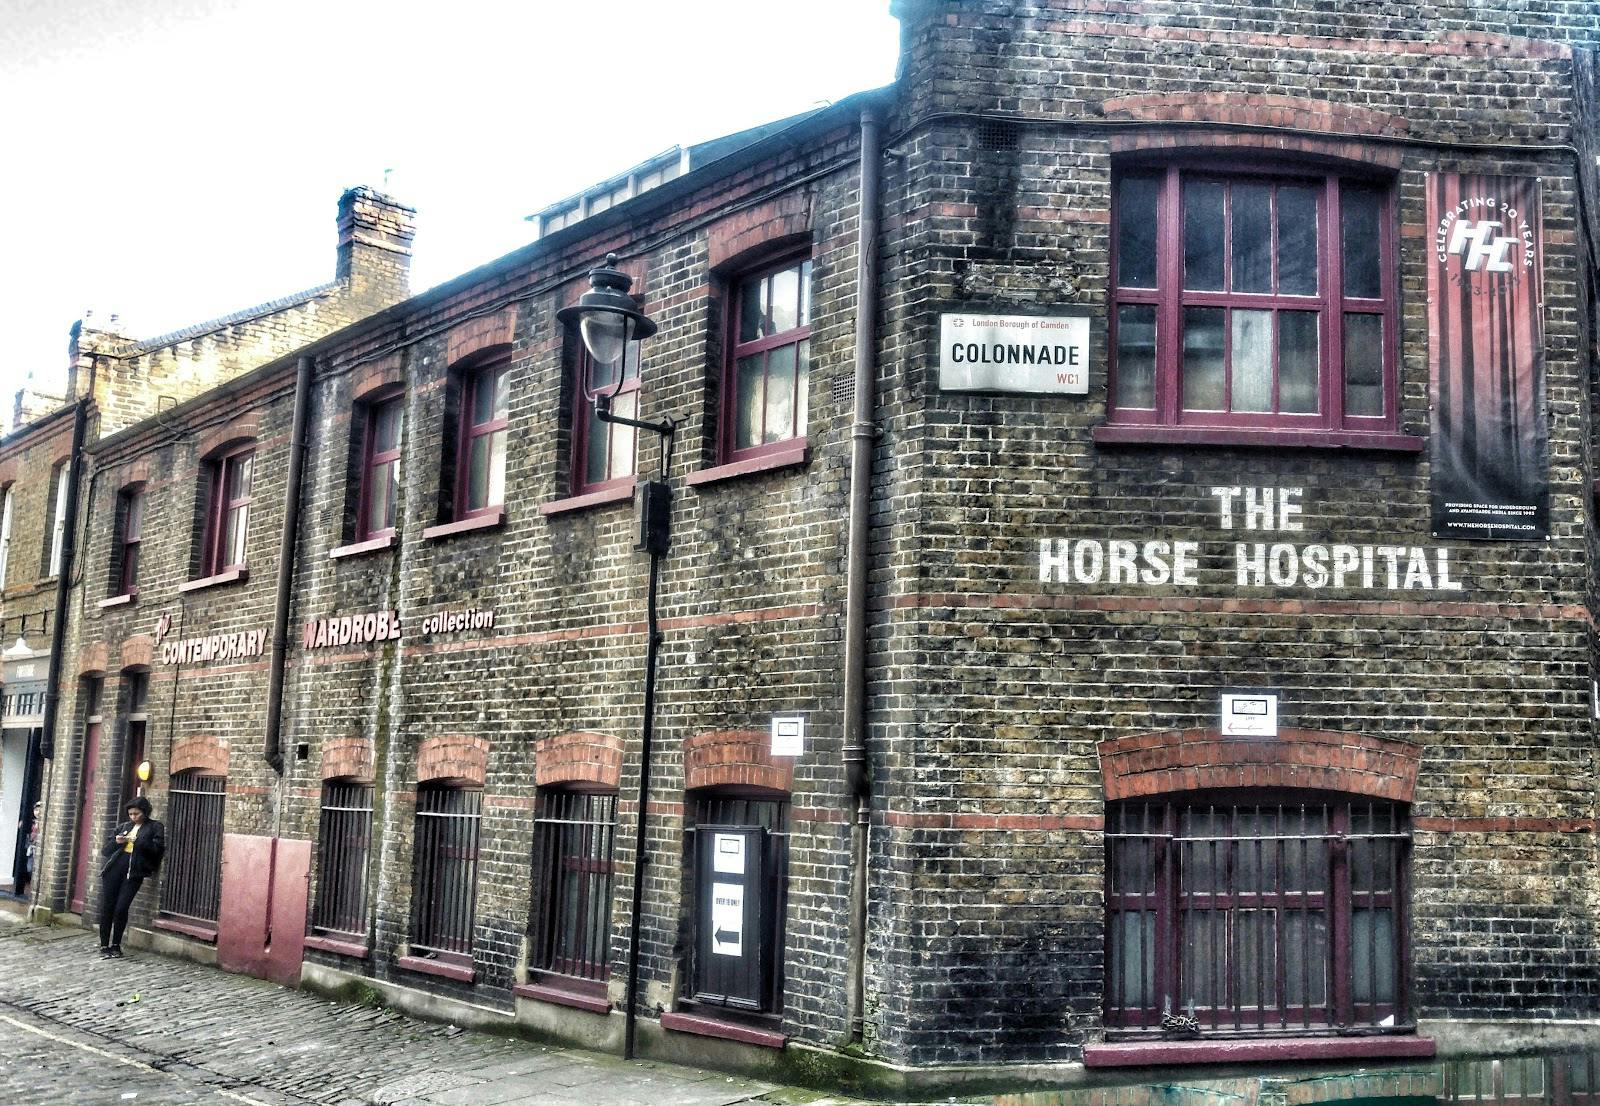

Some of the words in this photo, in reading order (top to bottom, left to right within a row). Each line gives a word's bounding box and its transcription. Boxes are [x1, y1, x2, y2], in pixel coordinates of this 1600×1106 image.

[1436, 197, 1495, 262] CELEBRATING
[1500, 202, 1517, 219] 20
[1519, 220, 1534, 267] YEARS
[1450, 273, 1520, 297] 193-20
[972, 318, 998, 328] London
[1000, 319, 1030, 329] Borough
[1031, 320, 1039, 329] of
[1040, 321, 1069, 330] Camden
[952, 343, 1079, 366] COLONNADE
[1057, 373, 1079, 385] WC1
[1211, 487, 1303, 531] THE
[1447, 522, 1536, 530] WWW.THEHORSEHOSPITAL.COM
[1039, 538, 1198, 585] HORSE
[1236, 543, 1462, 590] HOSPITAL
[162, 628, 269, 665] CONTEMPORARY
[303, 611, 401, 649] WARDROBE
[422, 608, 495, 635] collection
